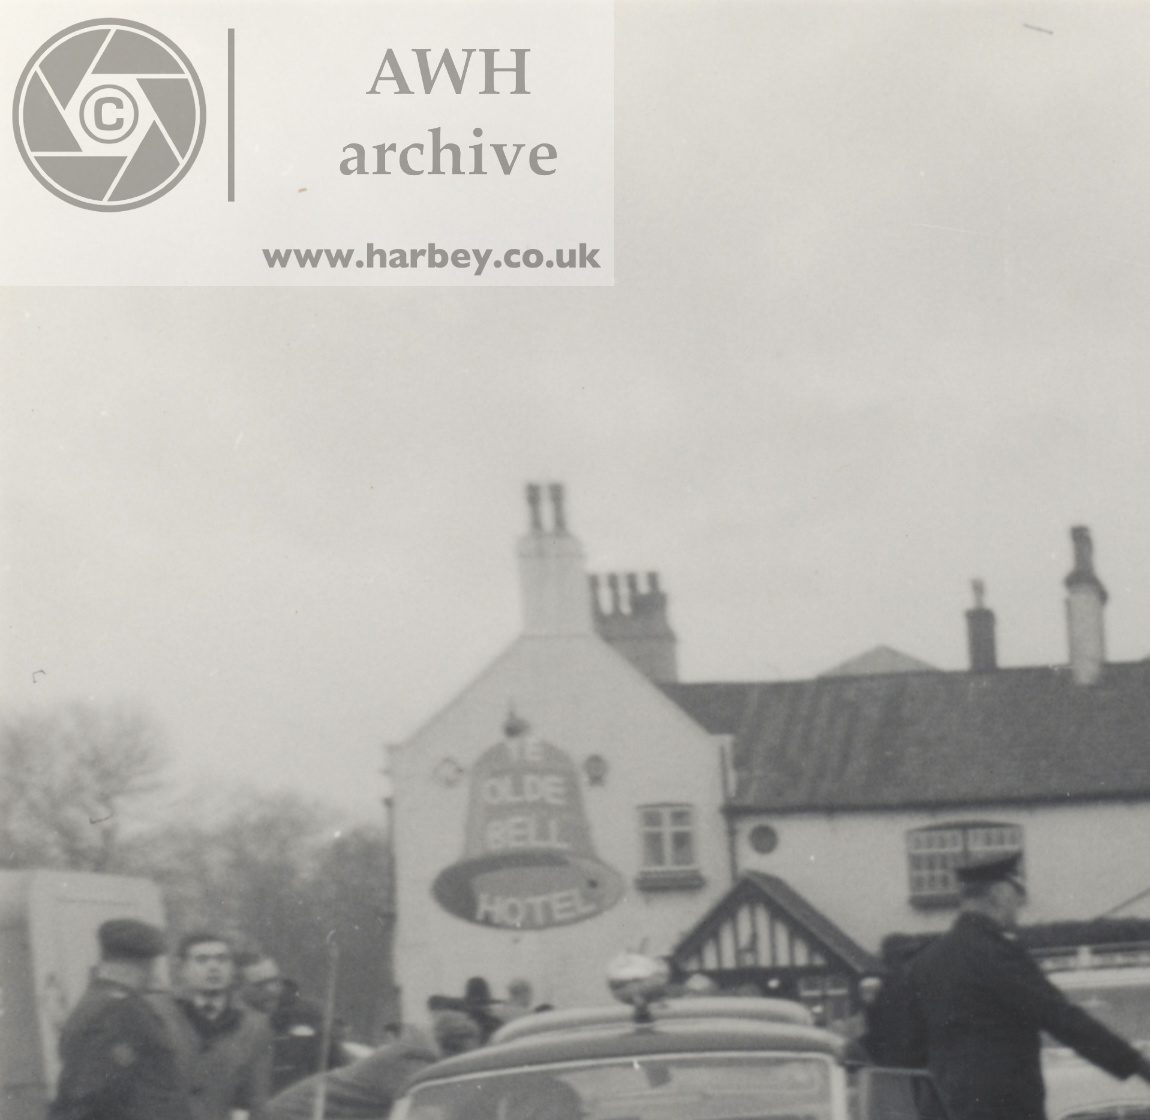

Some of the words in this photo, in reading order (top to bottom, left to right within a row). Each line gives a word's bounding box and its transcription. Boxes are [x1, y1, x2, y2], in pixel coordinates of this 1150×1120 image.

[481, 774, 568, 806] OLDE
[484, 813, 571, 851] BELL
[475, 887, 598, 926] HOTEL
